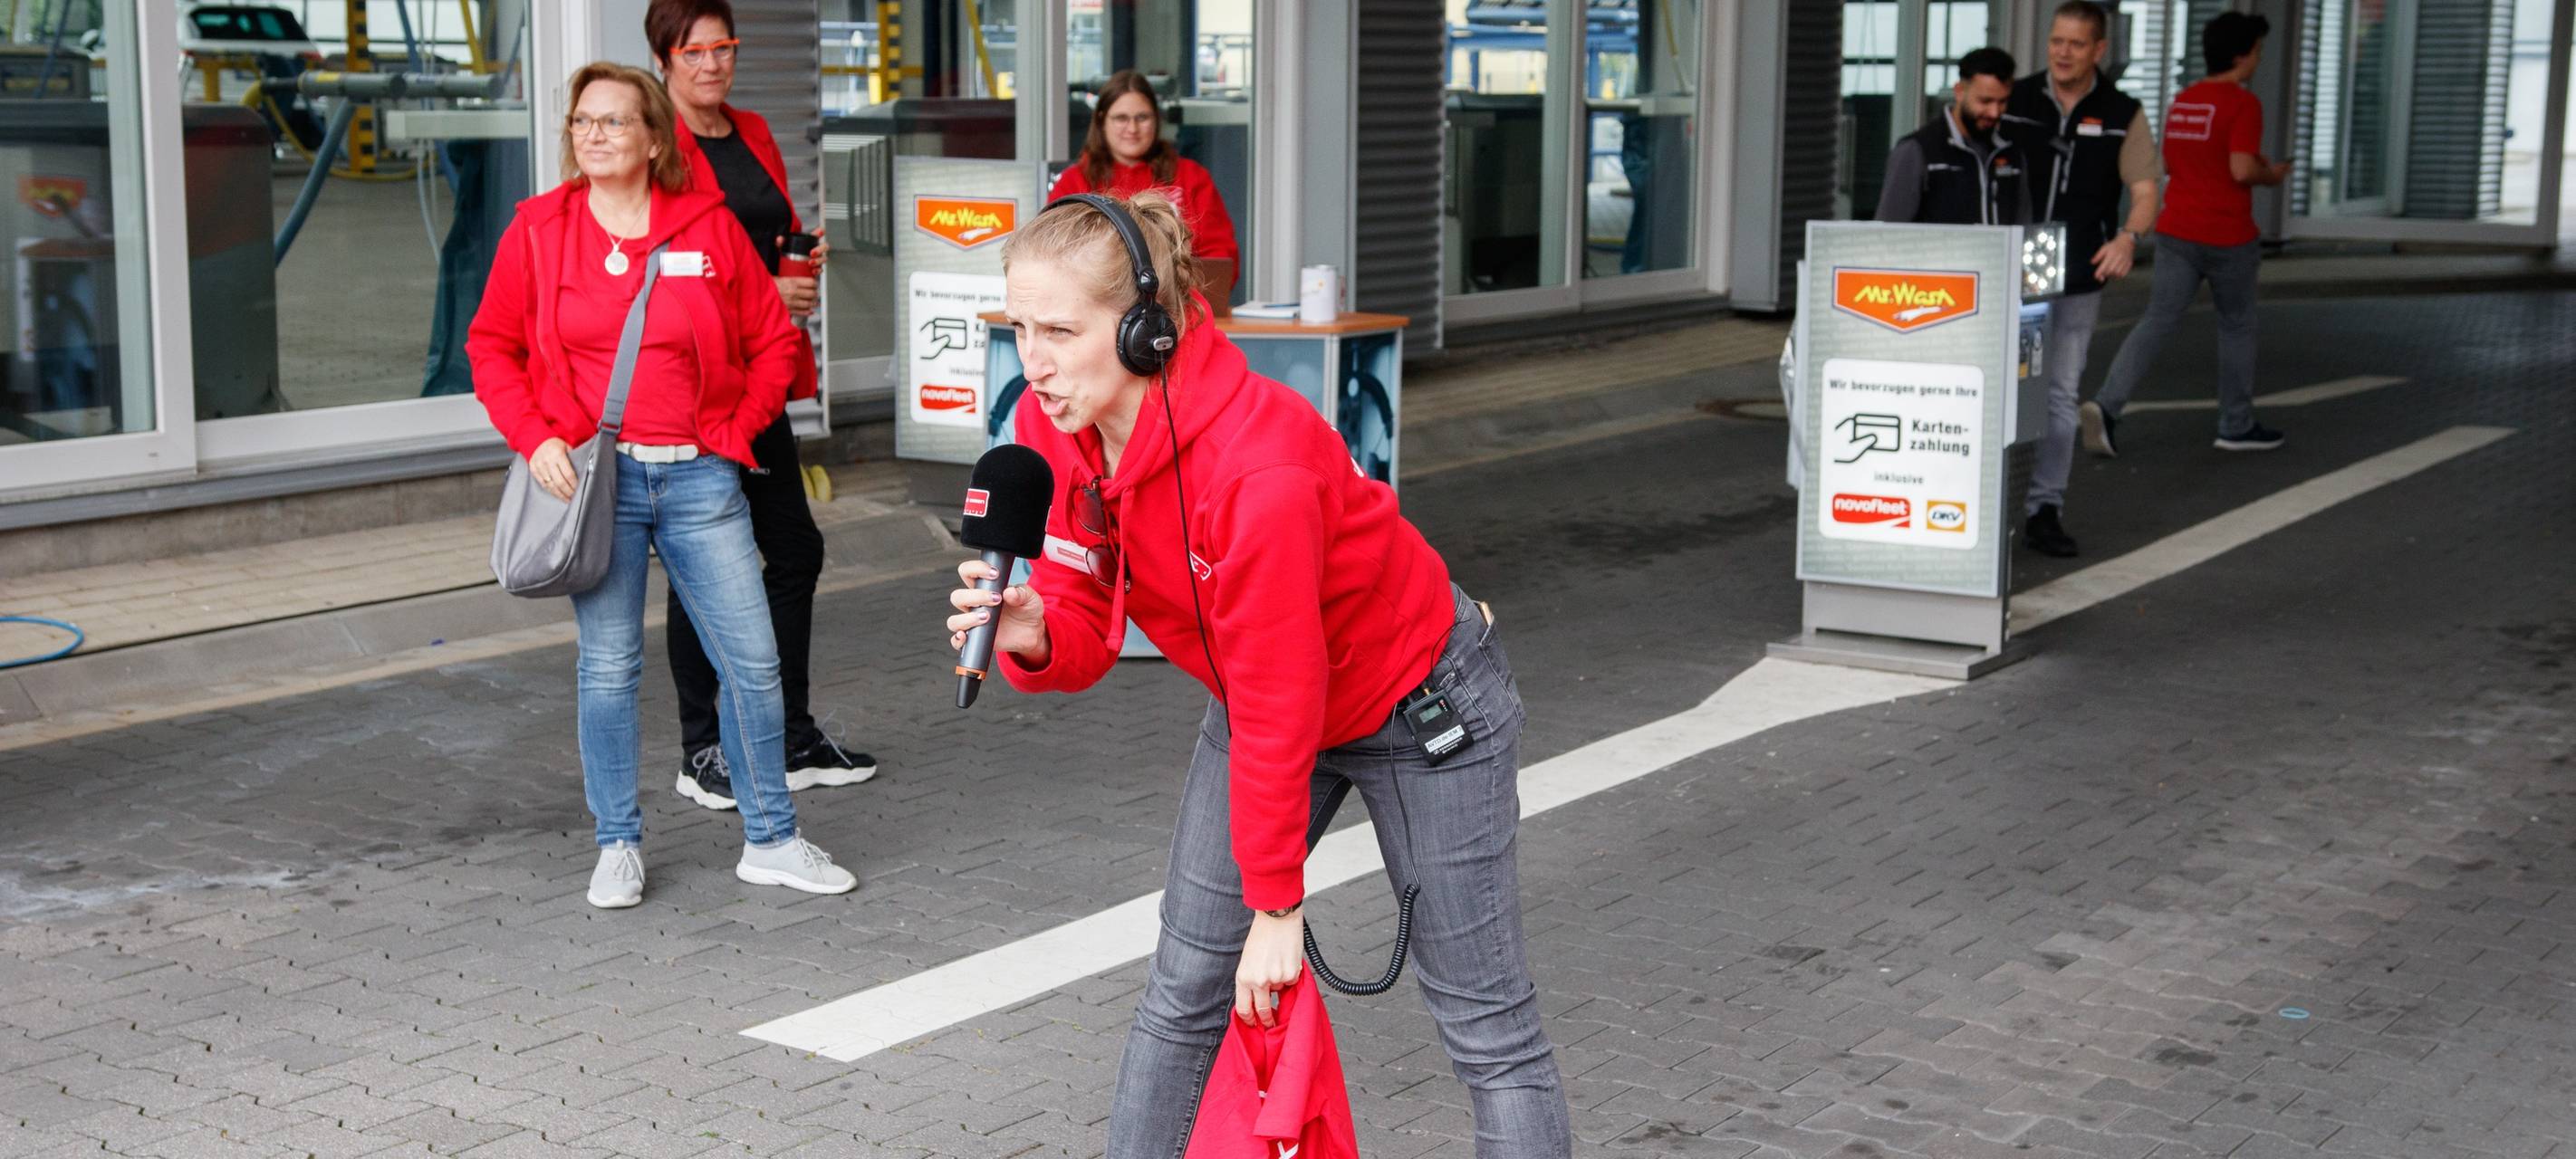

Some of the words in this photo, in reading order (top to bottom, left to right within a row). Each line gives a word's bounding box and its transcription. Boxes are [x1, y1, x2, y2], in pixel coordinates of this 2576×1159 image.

[1829, 379, 1847, 389] Wir
[1851, 380, 1915, 395] bevorzugen
[1919, 386, 1951, 396] gerne
[1955, 386, 1978, 397] Ihre
[1912, 419, 1969, 435] Karten-
[1909, 436, 1970, 456] zahlung
[1873, 471, 1925, 484] inklusive
[1834, 497, 1908, 515] novofleet
